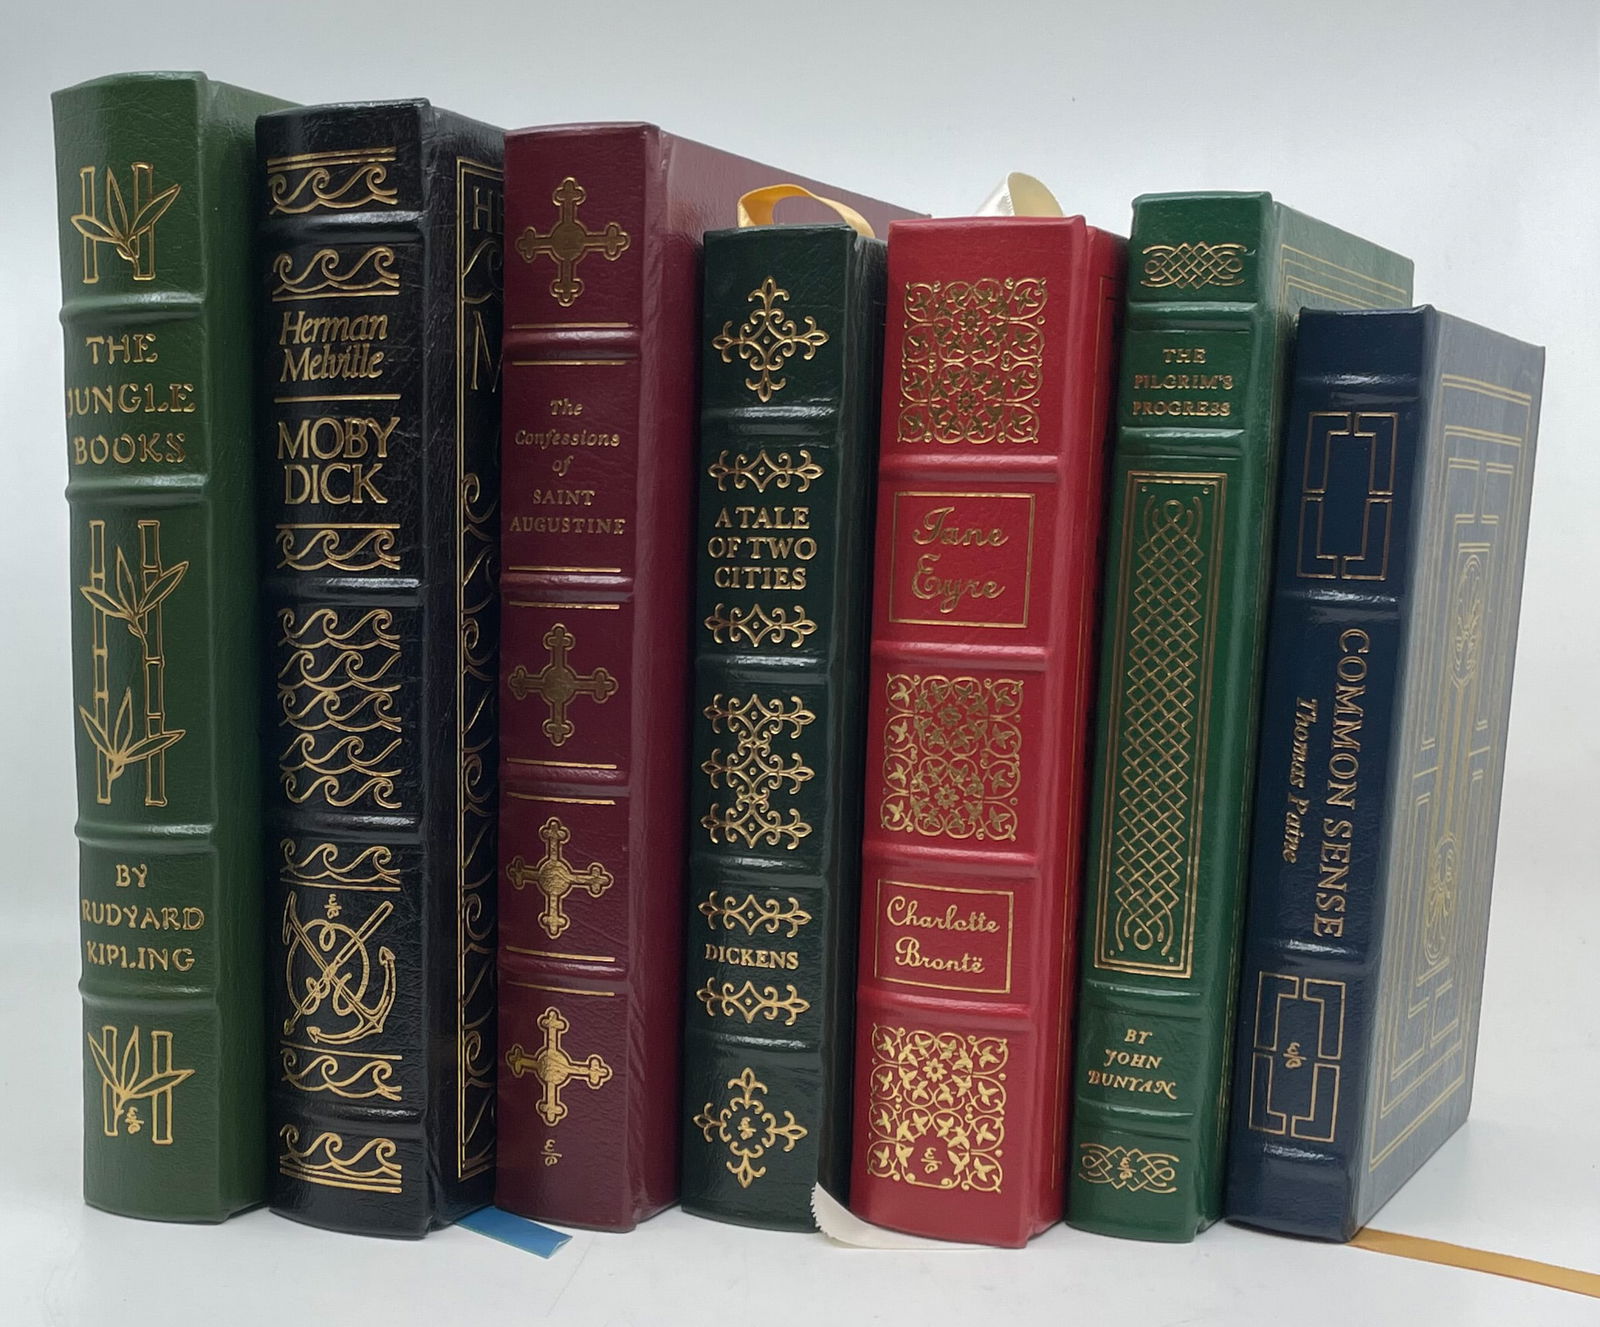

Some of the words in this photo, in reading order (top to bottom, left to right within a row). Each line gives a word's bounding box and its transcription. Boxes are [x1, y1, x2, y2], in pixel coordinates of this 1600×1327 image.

[279, 310, 388, 345] Herman
[86, 334, 158, 365] THE
[279, 343, 385, 382] Melville
[1163, 348, 1206, 363] THE
[1133, 374, 1233, 390] PILGRIM'S
[66, 383, 197, 419] JUNGLE
[550, 398, 584, 416] The
[1132, 401, 1231, 416] PROGRESS
[73, 432, 186, 465] BOOKS
[277, 416, 400, 460] MOBY
[515, 429, 620, 450] Confessions
[552, 455, 574, 477] of
[284, 462, 388, 504] DICK
[533, 489, 595, 506] SAINT
[509, 516, 626, 535] AUGUSTINE
[715, 507, 732, 528] A
[735, 506, 810, 529] TALE
[912, 506, 1009, 546] Jane
[708, 536, 741, 559] OF
[746, 536, 817, 560] TWO
[714, 566, 807, 590] CITIES
[911, 553, 1006, 613] Eyre
[1325, 628, 1370, 810] COMMON
[1289, 696, 1318, 788] Thomas
[1282, 792, 1310, 864] Paine
[115, 863, 148, 888] BY
[1312, 818, 1353, 938] SENSE
[81, 899, 205, 931] RUDYARD
[887, 896, 1000, 932] Charlotte
[86, 940, 195, 971] KIPLING
[705, 943, 799, 970] DICKENS
[895, 936, 985, 973] Brontë
[1124, 1029, 1153, 1044] BY
[1103, 1049, 1162, 1069] JOHN
[1088, 1070, 1178, 1100] BUNYAN
